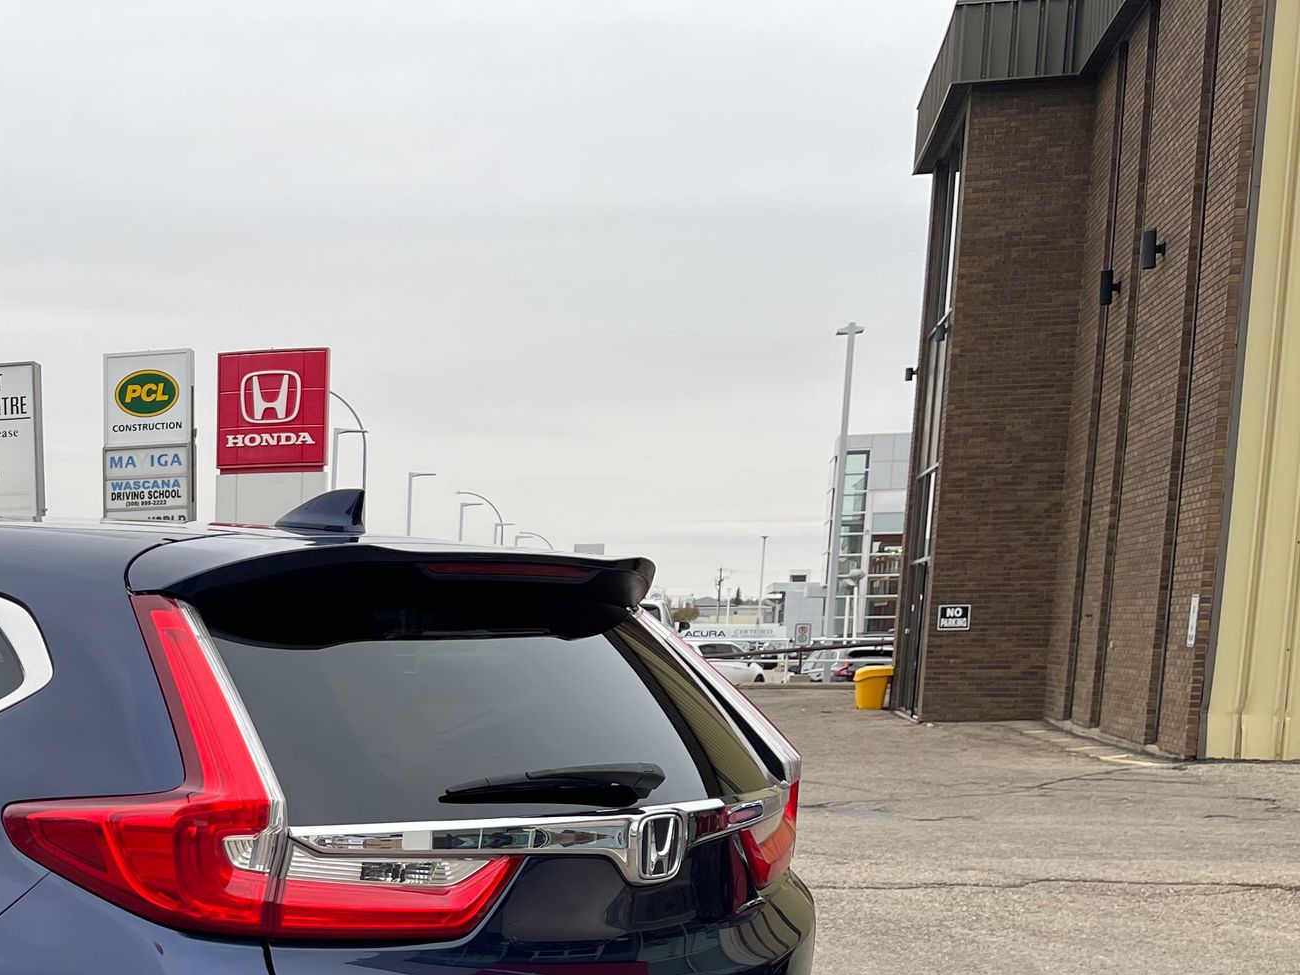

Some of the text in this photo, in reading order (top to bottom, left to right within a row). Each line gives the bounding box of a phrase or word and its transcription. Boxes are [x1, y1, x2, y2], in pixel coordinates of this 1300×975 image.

[124, 383, 169, 403] PCL
[112, 421, 183, 433] CONSTRUCTION
[226, 432, 316, 448] HONDA
[111, 479, 181, 491] WASCANA
[111, 489, 182, 501] DRIVING SCHOOL
[946, 607, 963, 617] NO
[684, 630, 726, 638] ACURA
